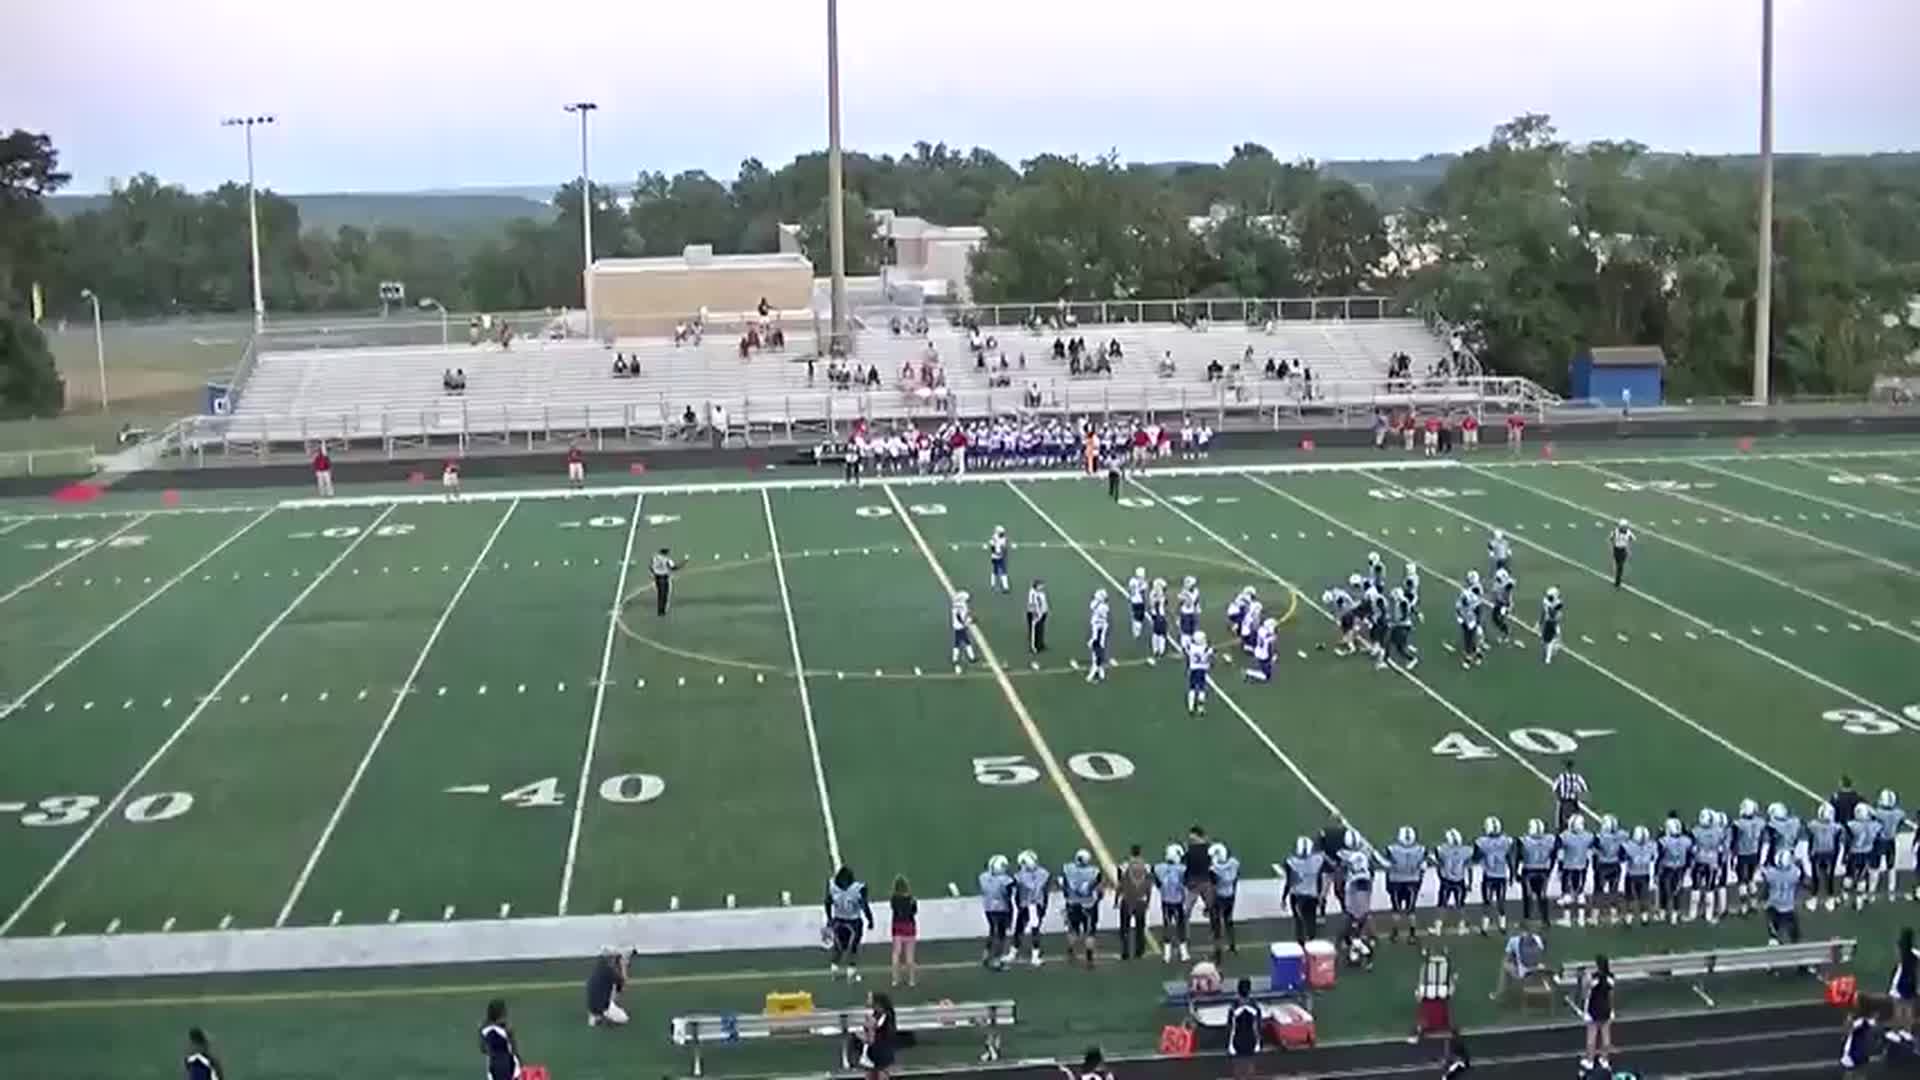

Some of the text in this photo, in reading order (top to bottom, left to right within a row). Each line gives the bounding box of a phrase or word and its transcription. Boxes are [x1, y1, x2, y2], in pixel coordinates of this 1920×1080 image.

[1431, 728, 1578, 760] 40
[972, 752, 1136, 785] 50
[501, 773, 667, 808] 40
[19, 790, 196, 827] 30
